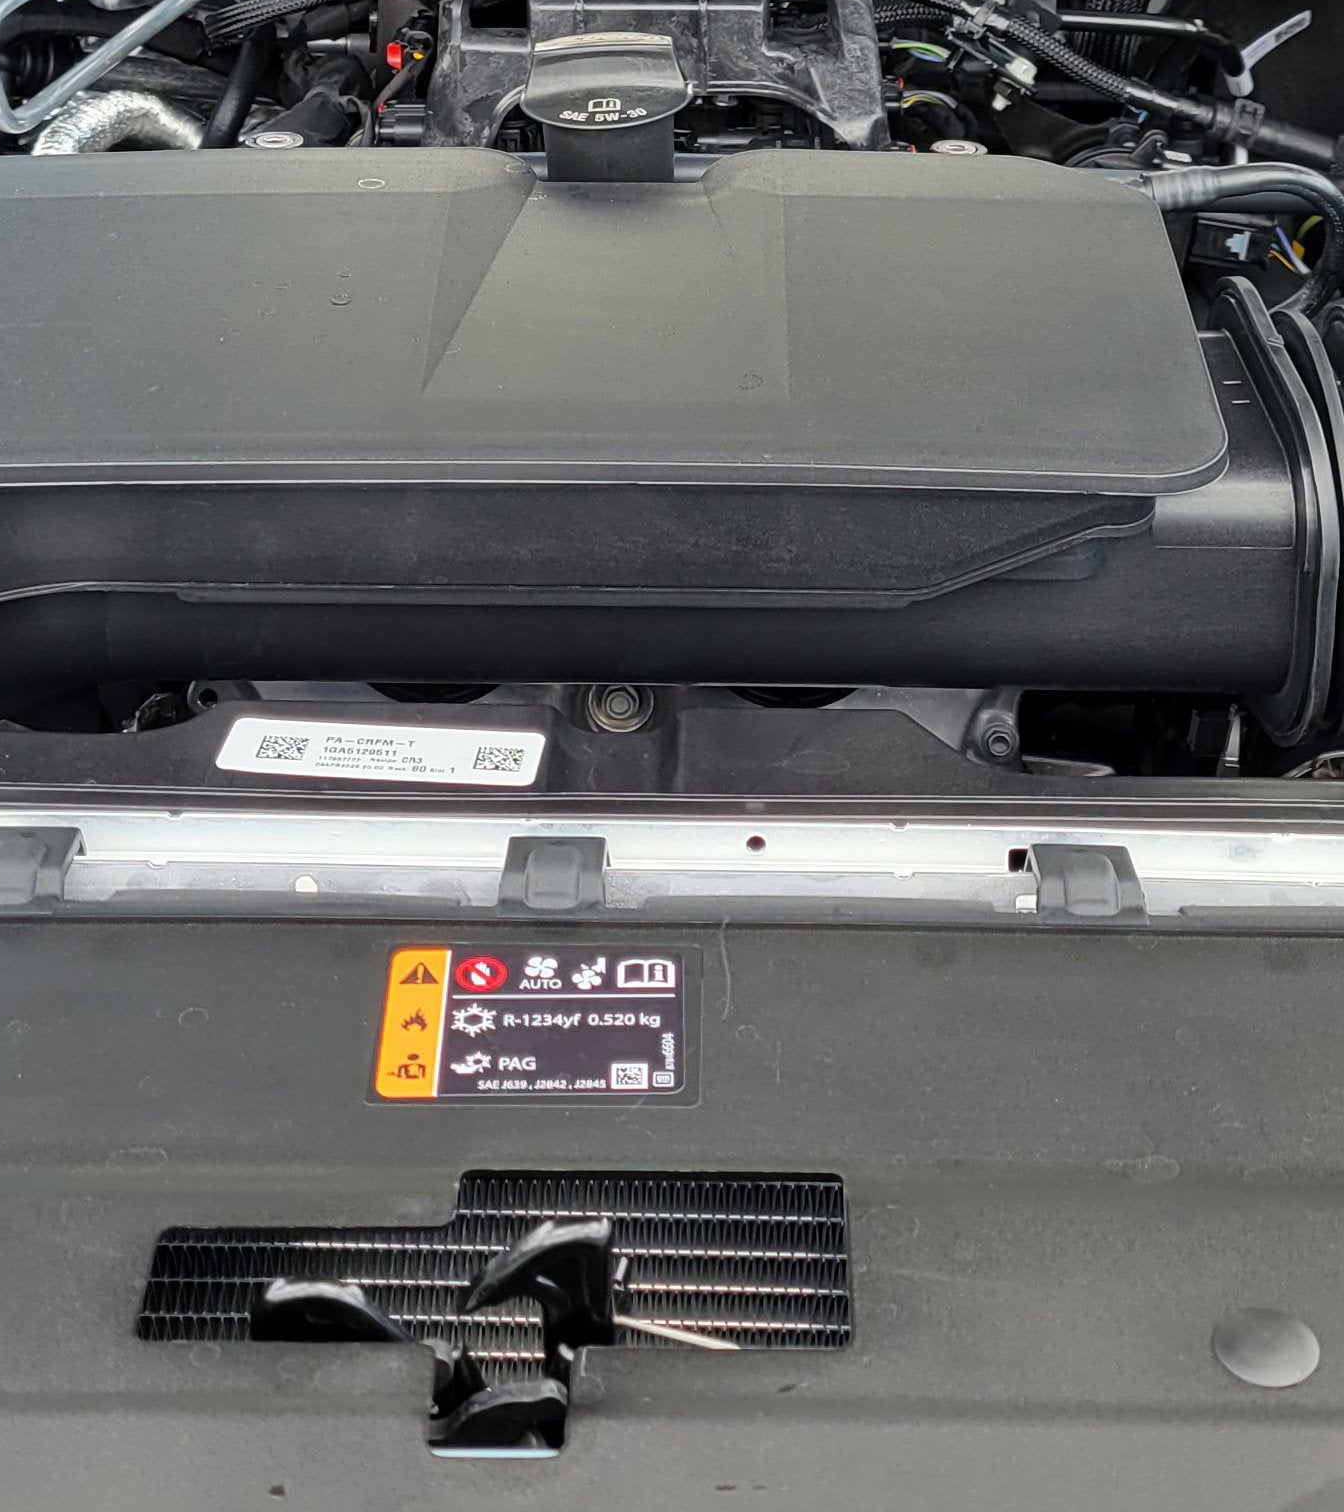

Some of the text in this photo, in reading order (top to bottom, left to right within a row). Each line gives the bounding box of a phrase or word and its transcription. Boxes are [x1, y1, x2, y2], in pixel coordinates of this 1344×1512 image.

[559, 107, 648, 122] SAE 5W-30
[519, 979, 562, 989] AUTO
[503, 1012, 660, 1028] R-1234yf 0.520 kg
[499, 1056, 537, 1070] PAG
[477, 1080, 498, 1089] SAE
